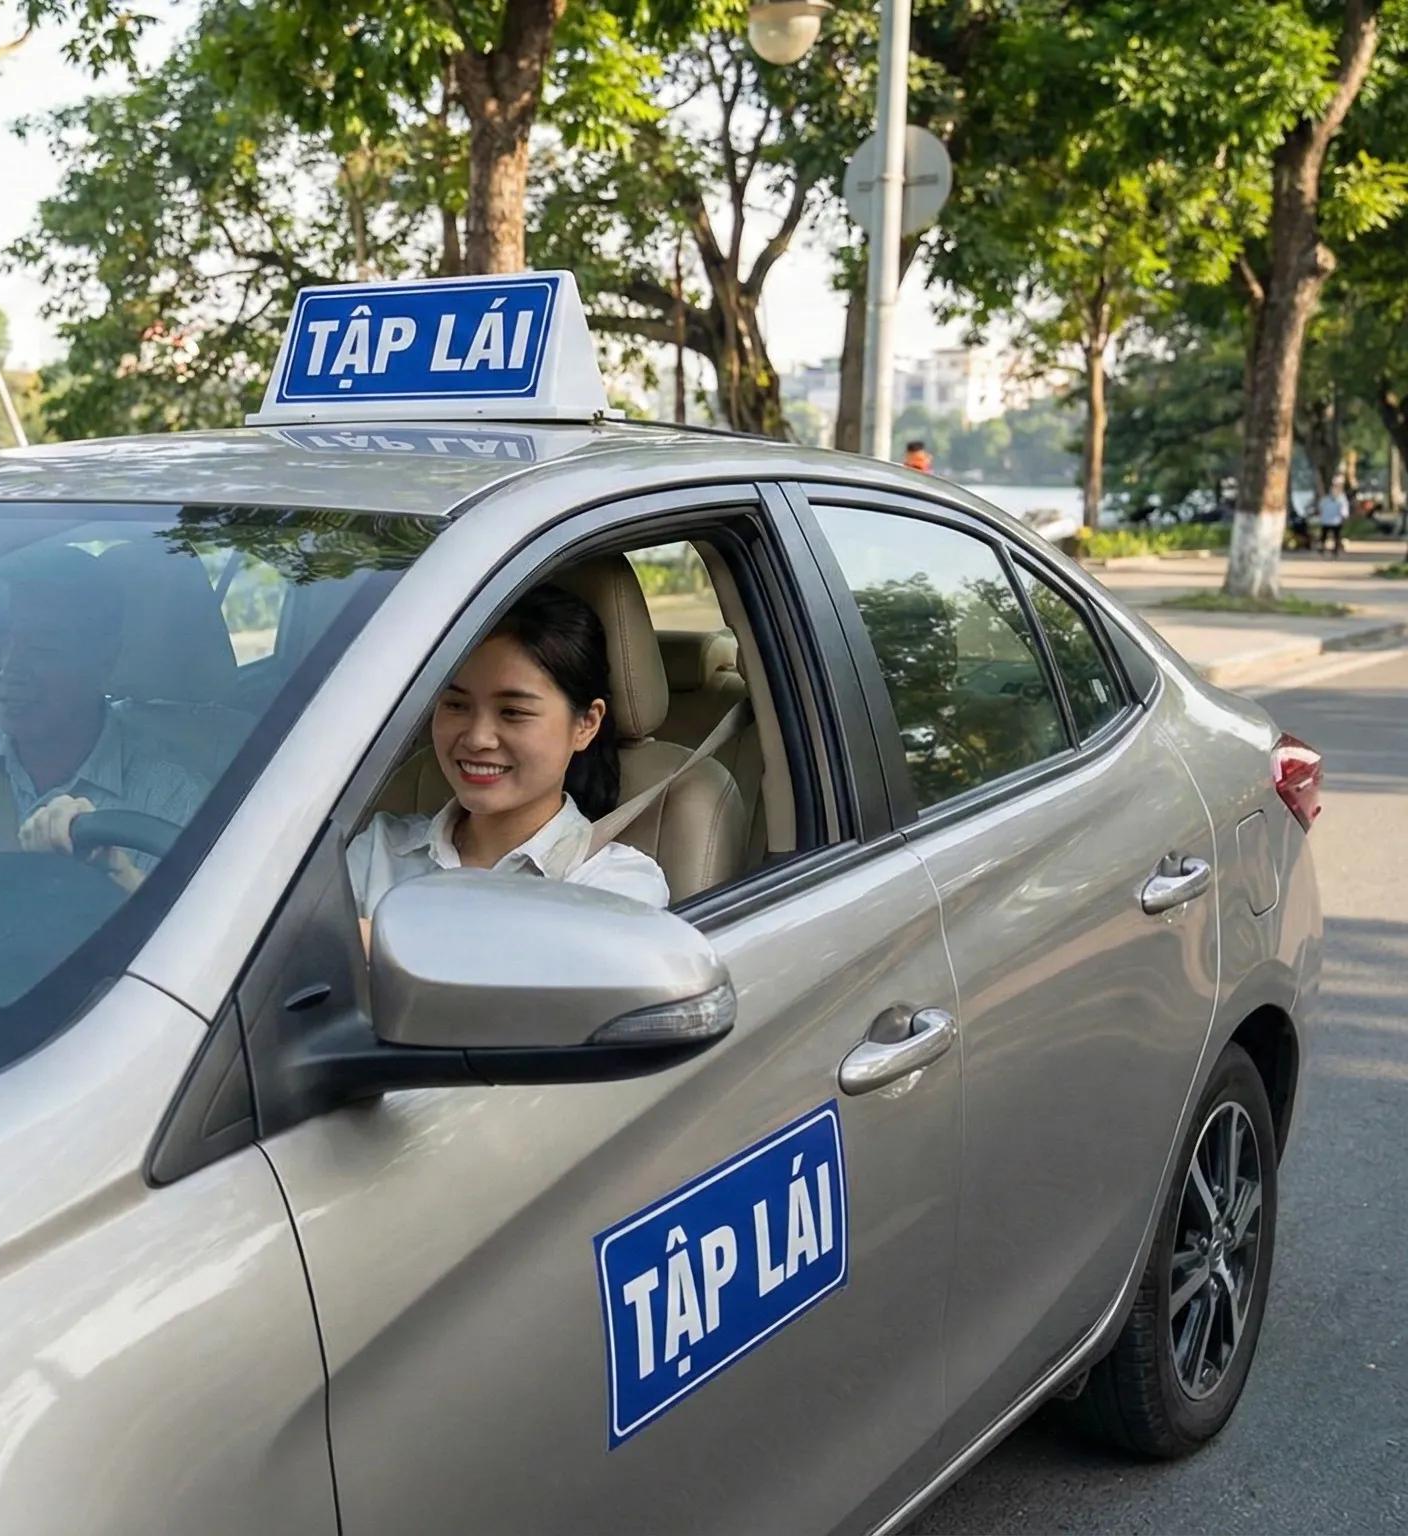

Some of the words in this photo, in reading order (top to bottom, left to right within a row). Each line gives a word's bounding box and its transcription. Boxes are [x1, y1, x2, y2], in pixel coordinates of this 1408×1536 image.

[306, 305, 417, 390] TẬP
[429, 297, 534, 372] LÁI
[623, 1225, 738, 1380] TẬP
[753, 1152, 834, 1297] LÁI
